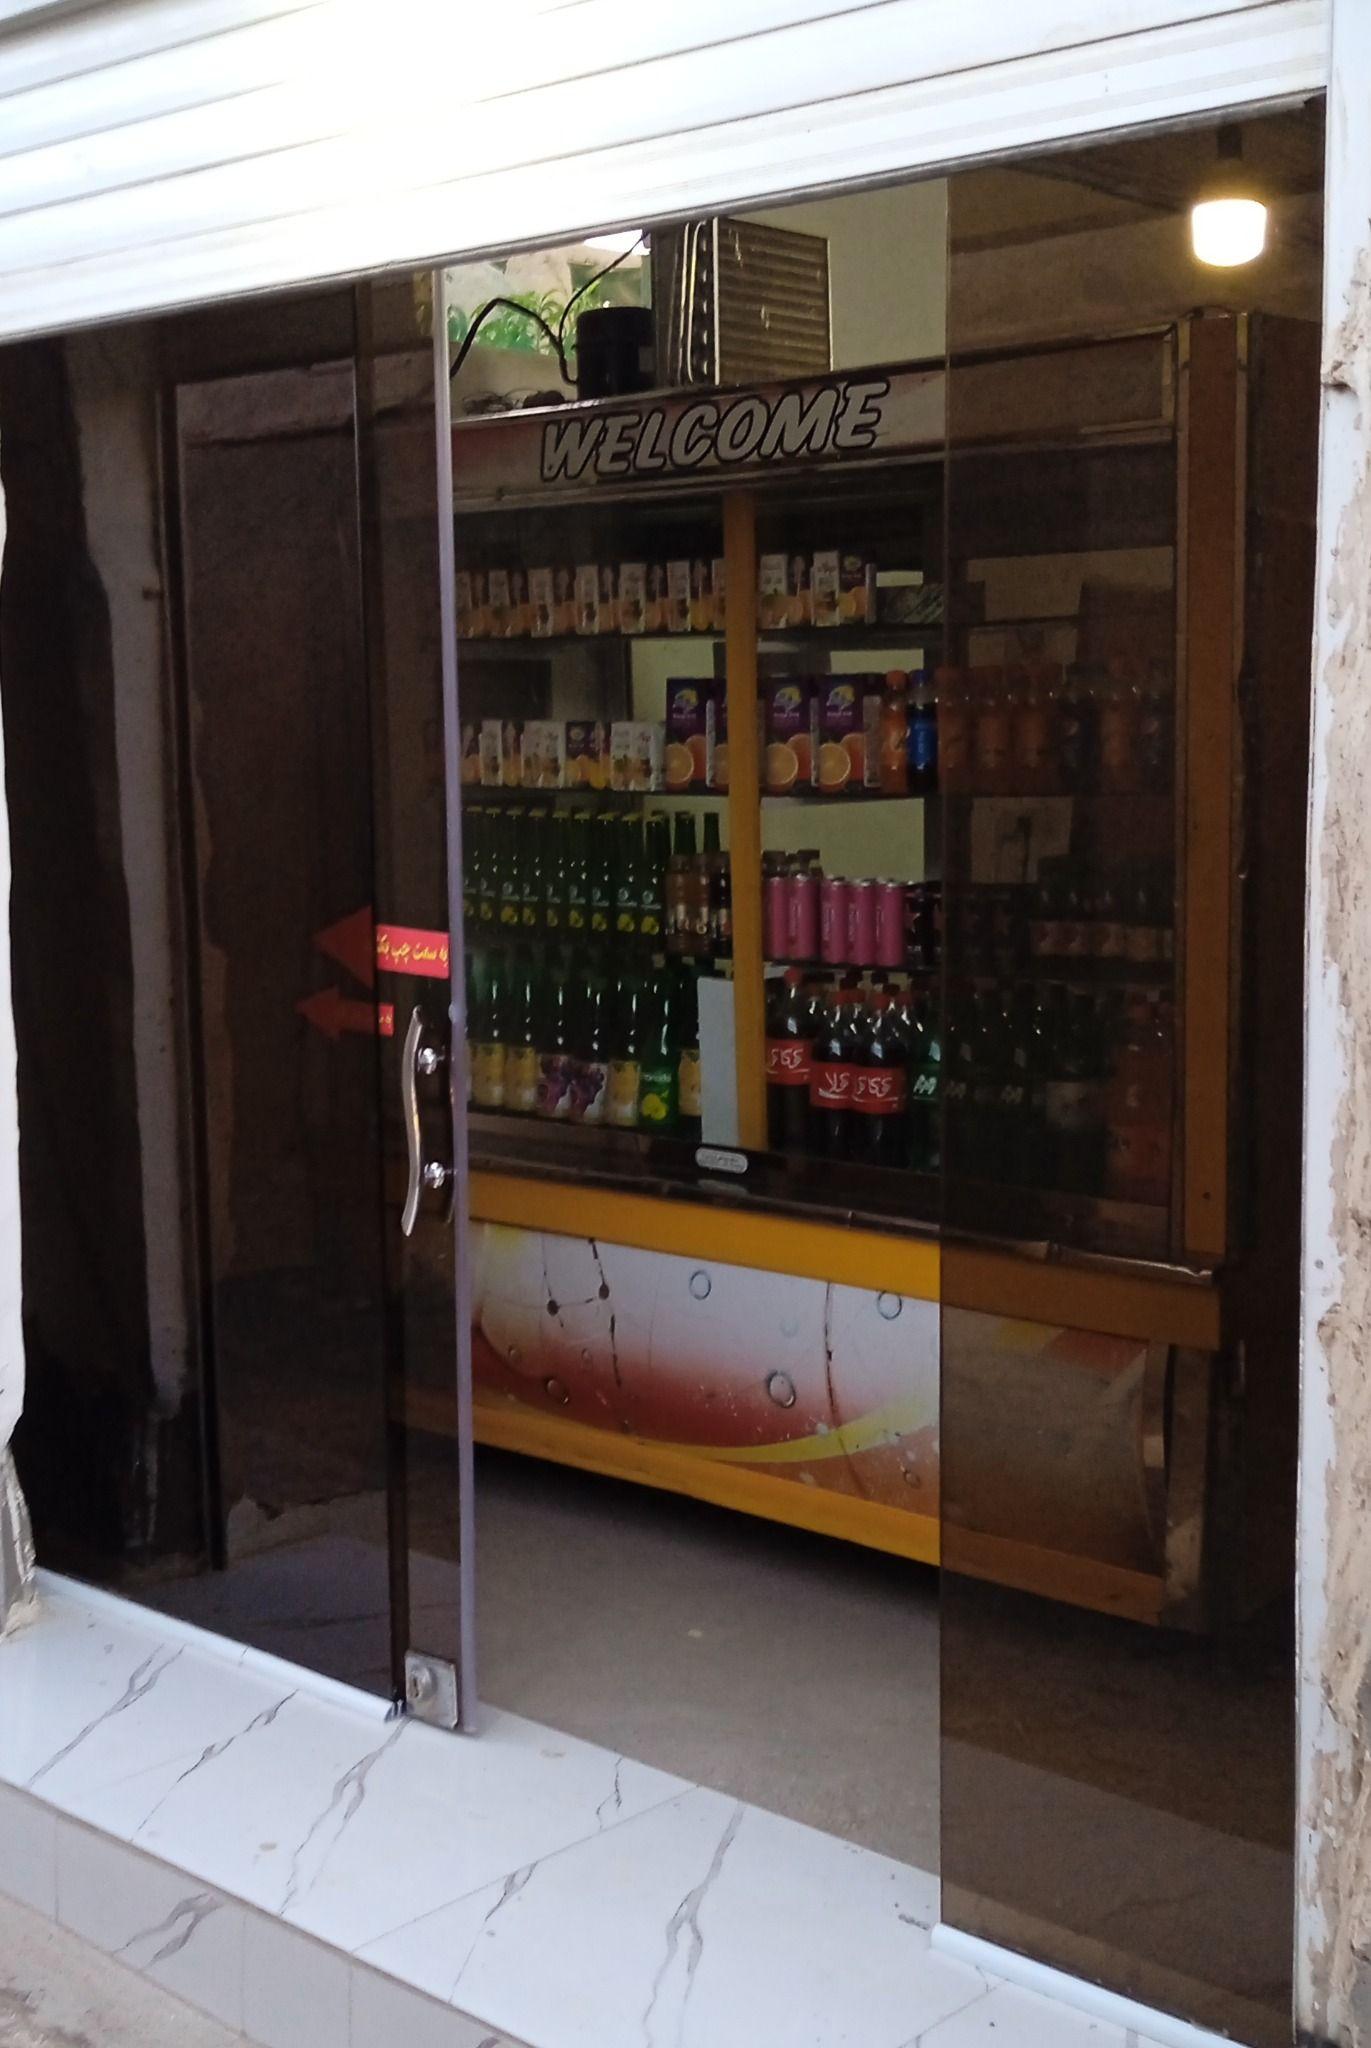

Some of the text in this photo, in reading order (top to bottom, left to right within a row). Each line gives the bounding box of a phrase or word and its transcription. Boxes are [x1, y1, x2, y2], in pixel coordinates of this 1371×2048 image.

[543, 380, 888, 481] WELCOME
[391, 942, 411, 966] چپ
[412, 942, 437, 961] سمت
